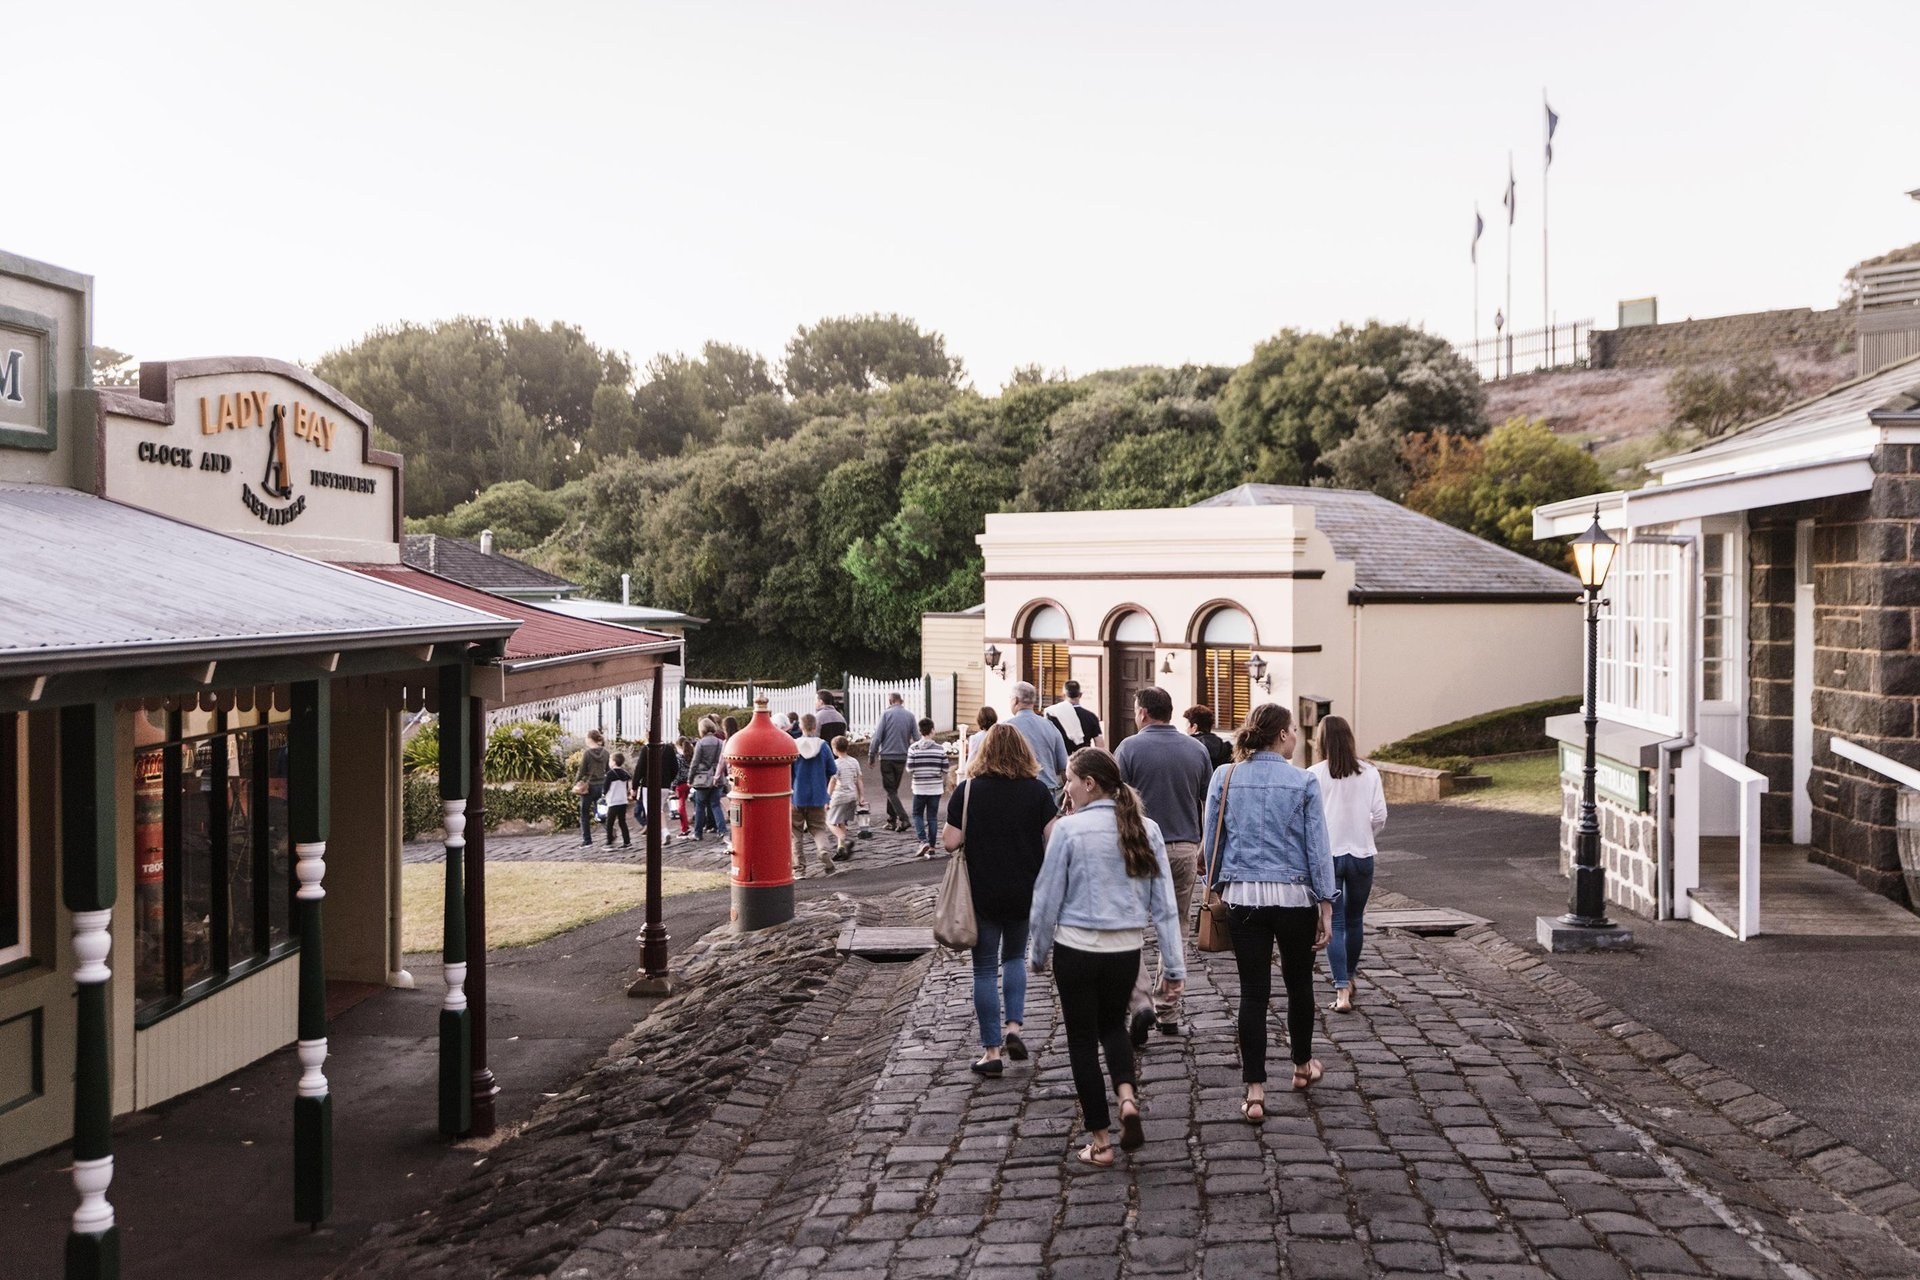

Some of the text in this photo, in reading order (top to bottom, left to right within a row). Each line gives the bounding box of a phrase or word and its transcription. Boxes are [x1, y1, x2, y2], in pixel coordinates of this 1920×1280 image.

[200, 390, 336, 452] LADY BAY
[138, 441, 376, 495] CLOCK AND INSTRUMENT
[242, 483, 307, 525] REPAIRER
